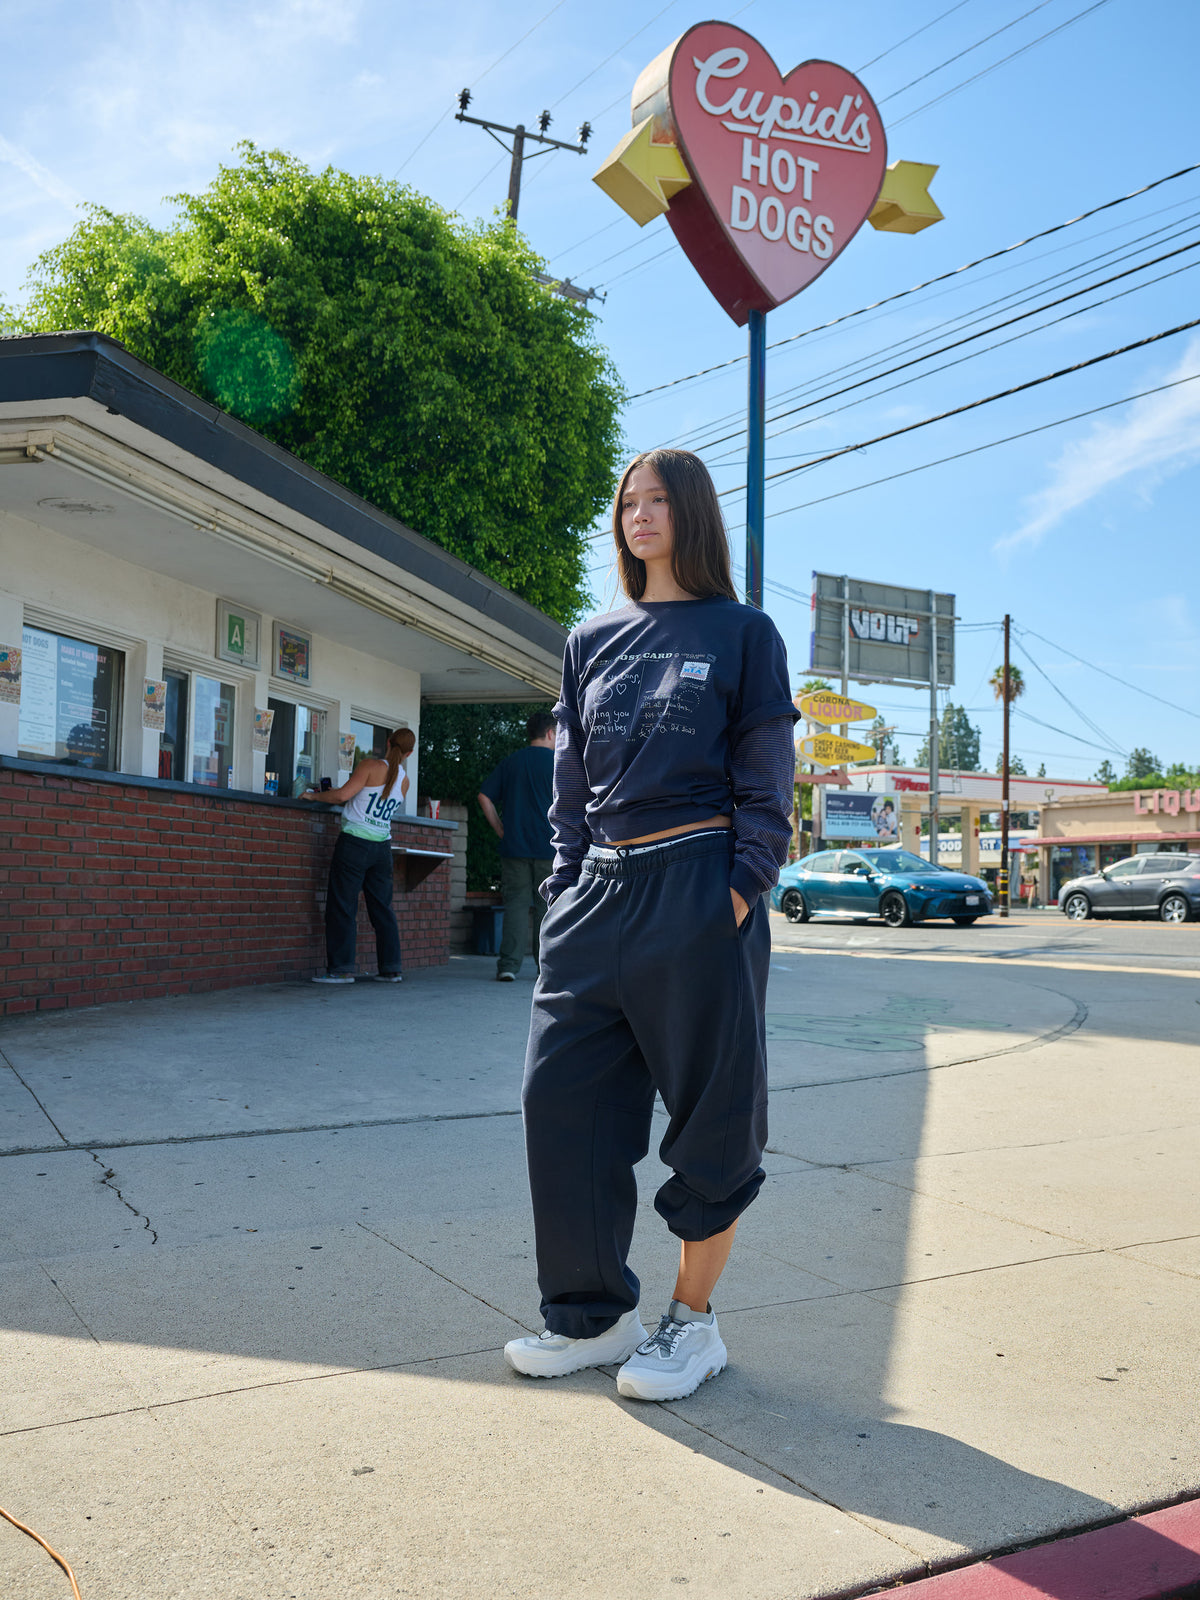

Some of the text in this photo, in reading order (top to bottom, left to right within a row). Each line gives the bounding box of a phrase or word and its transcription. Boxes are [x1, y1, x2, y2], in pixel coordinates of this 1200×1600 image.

[693, 47, 871, 147] Cupid's
[741, 138, 819, 201] HOT
[731, 184, 835, 260] DOGS
[231, 624, 242, 647] A
[809, 702, 863, 719] LIQUOR
[813, 695, 850, 705] CORONA
[937, 840, 962, 851] OOD
